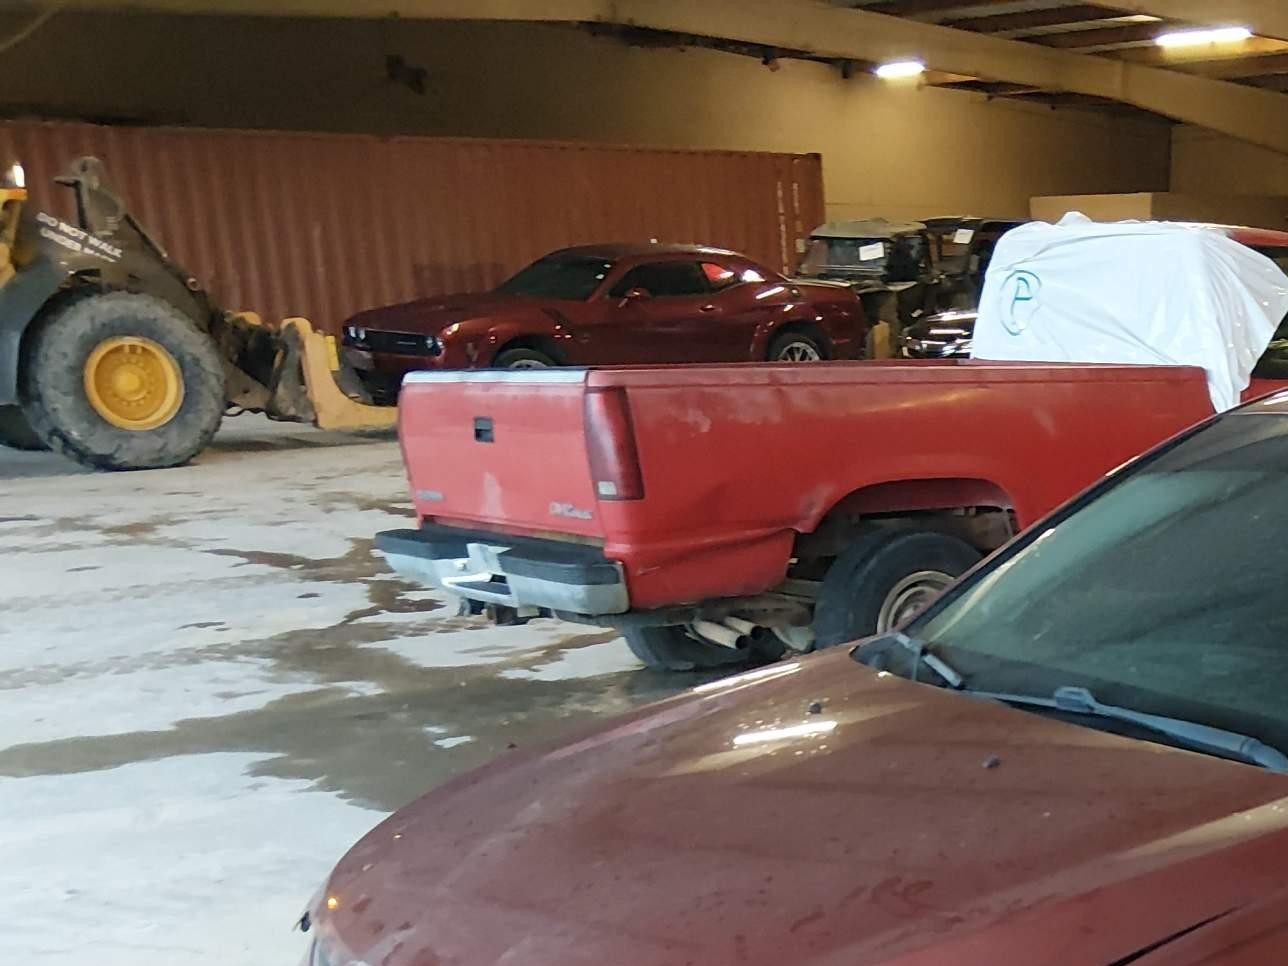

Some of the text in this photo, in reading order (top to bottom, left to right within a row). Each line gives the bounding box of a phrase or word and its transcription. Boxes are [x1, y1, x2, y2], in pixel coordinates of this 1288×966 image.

[36, 211, 59, 227] DO
[59, 222, 88, 240] NOT
[88, 235, 122, 258] WALK
